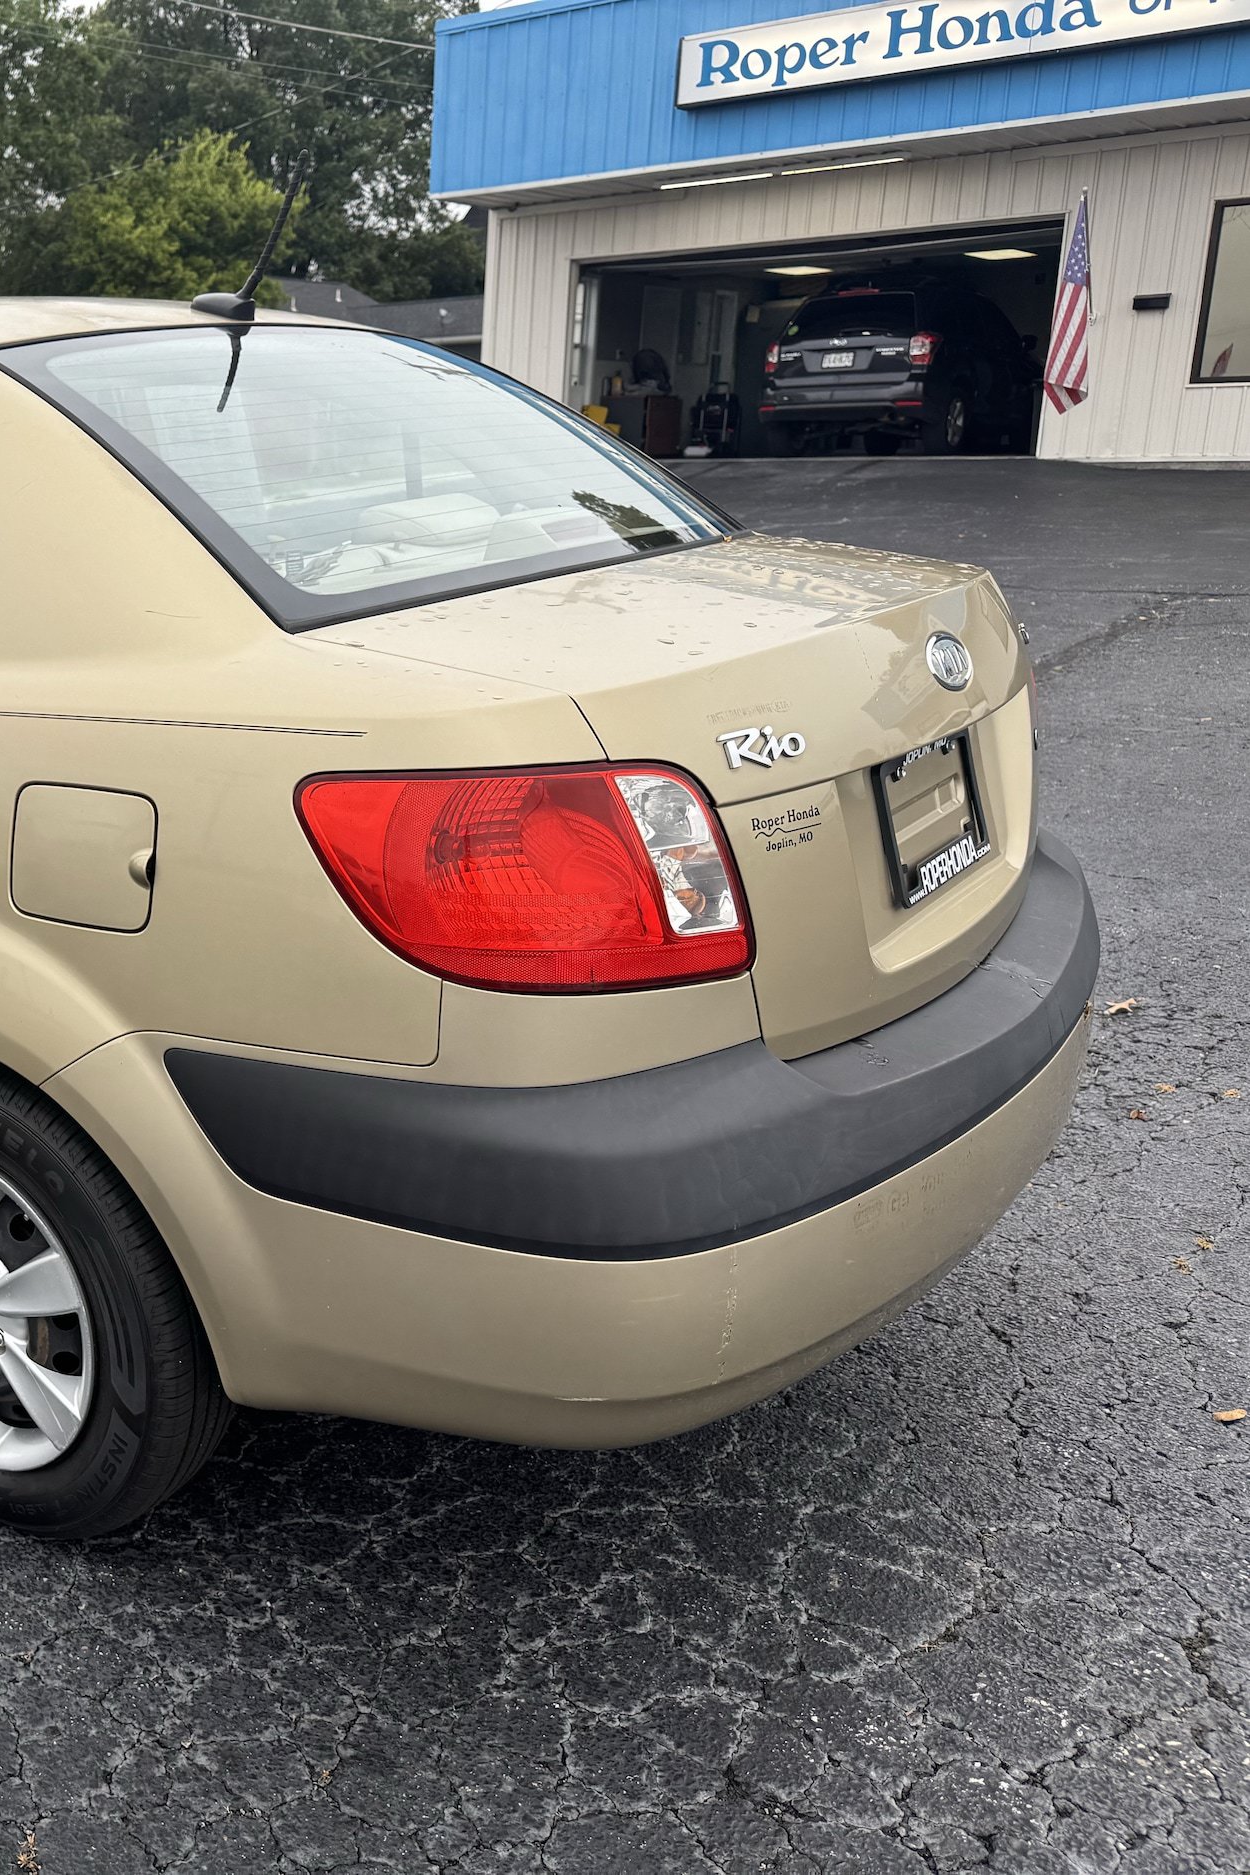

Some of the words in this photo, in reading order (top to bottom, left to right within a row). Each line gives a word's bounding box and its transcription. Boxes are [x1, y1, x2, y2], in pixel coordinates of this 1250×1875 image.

[696, 30, 870, 88] Roper
[882, 0, 1102, 59] Honda
[716, 725, 807, 769] Rio
[751, 815, 785, 831] Roper
[787, 805, 821, 823] Honda
[765, 837, 798, 852] Joplin,
[798, 831, 814, 844] MO
